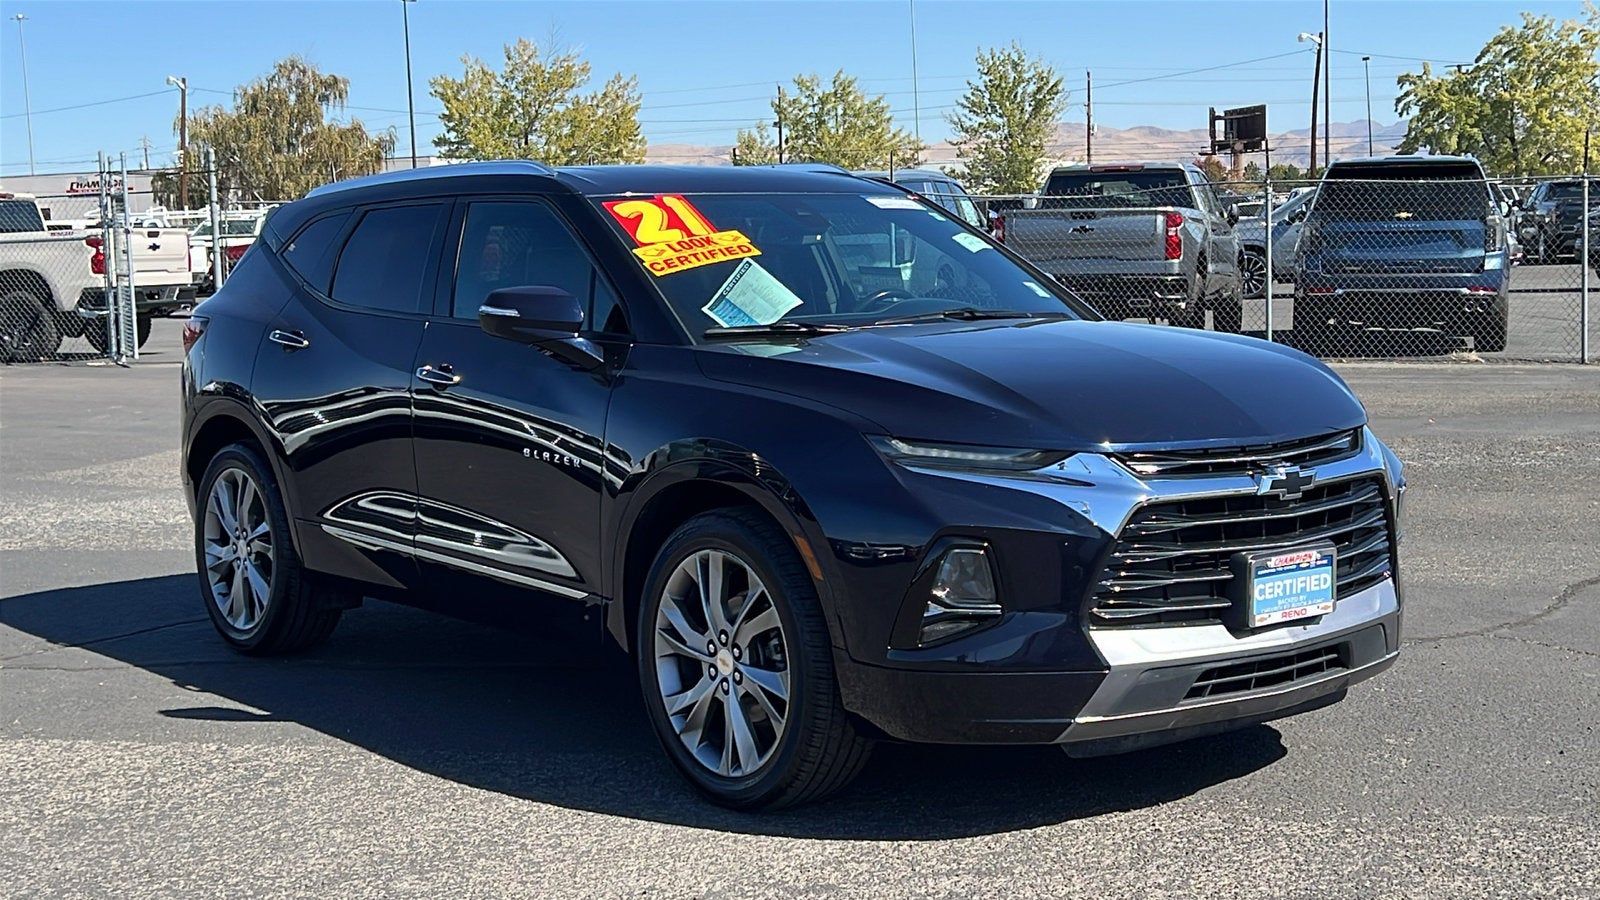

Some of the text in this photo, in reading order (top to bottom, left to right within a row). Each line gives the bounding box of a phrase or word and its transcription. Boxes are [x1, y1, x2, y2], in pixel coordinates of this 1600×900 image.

[70, 180, 125, 191] CHAMION
[612, 196, 714, 244] 21
[665, 236, 719, 253] LOOK
[649, 244, 752, 272] CERTIFIED
[722, 262, 750, 296] CERTIFIED
[523, 448, 581, 468] BLAZER
[1273, 552, 1314, 567] CHAMPION
[1255, 573, 1331, 601] CERTIFIED
[1281, 608, 1308, 619] RENO
